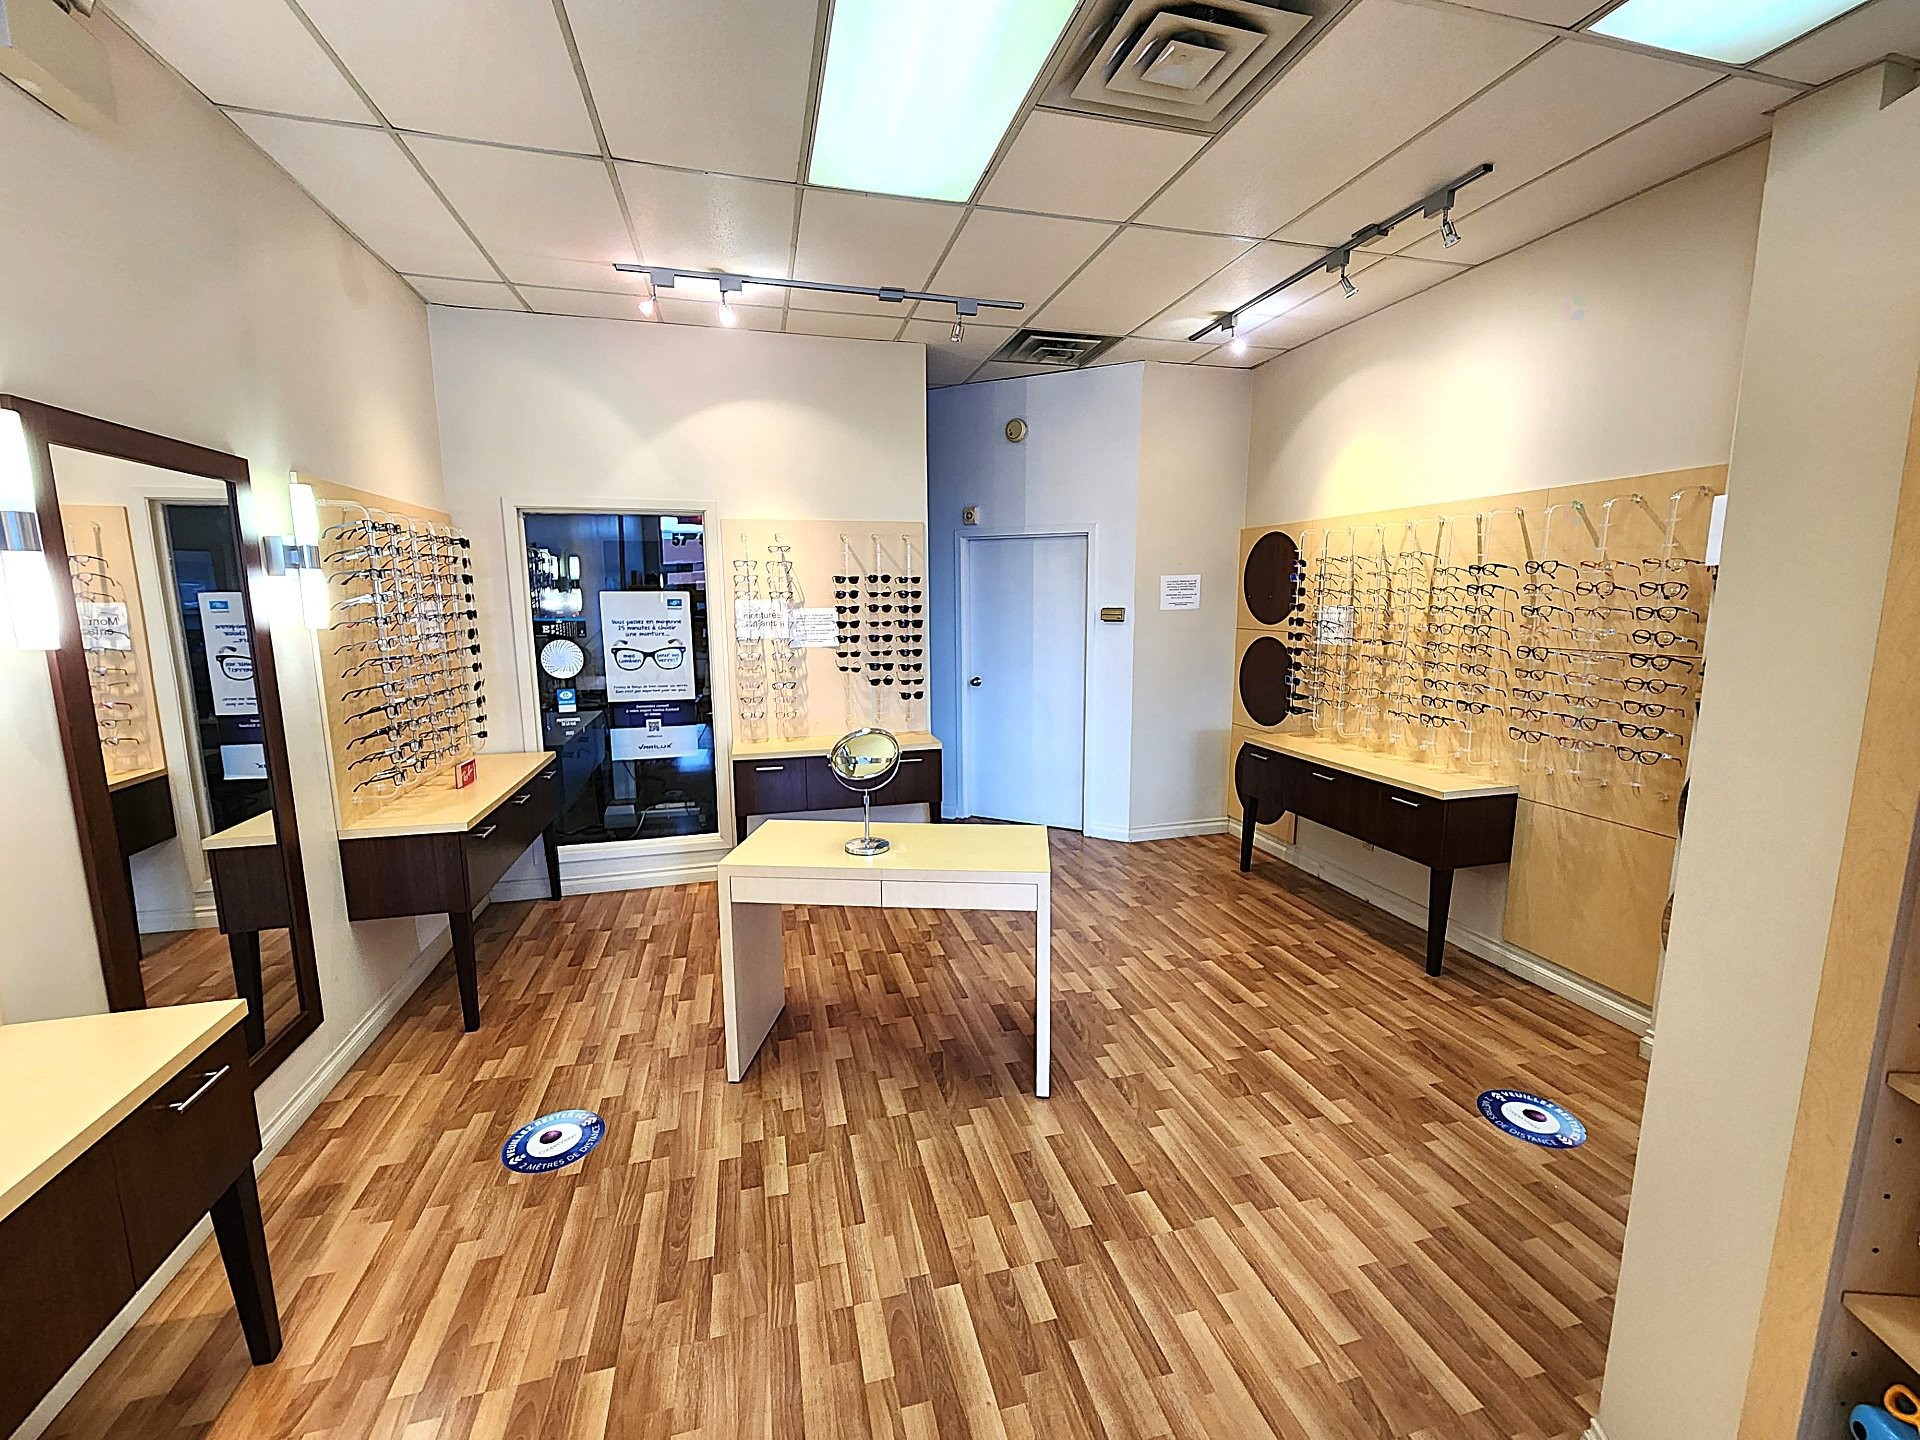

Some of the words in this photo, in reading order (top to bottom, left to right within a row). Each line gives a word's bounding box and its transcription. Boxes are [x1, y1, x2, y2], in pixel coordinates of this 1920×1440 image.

[1501, 1091, 1555, 1109] VEUILLEZ
[507, 1125, 535, 1158] VEUILLEZ
[526, 1160, 565, 1171] MÈTRES
[567, 1152, 580, 1160] DE
[580, 1124, 600, 1153] DISTANCE
[1495, 1120, 1508, 1129] DE
[1509, 1128, 1558, 1146] DISTANCE
